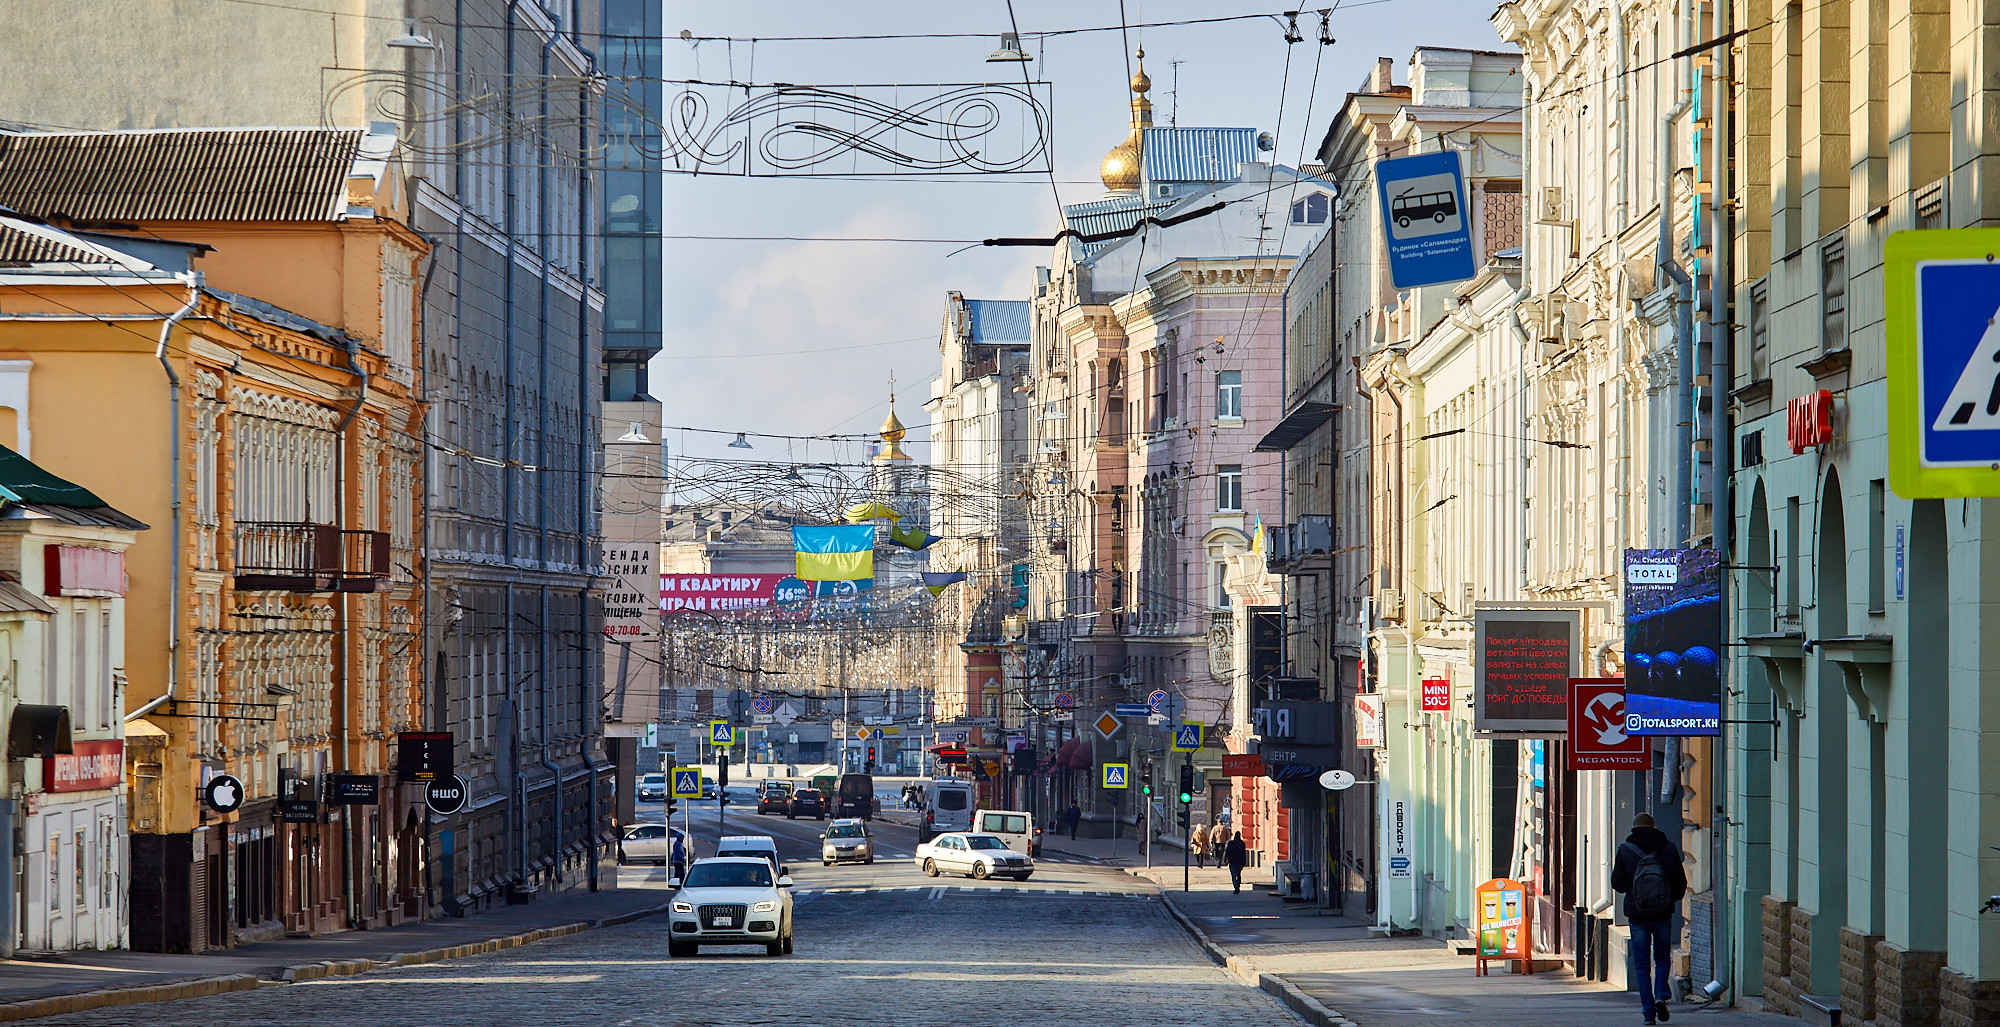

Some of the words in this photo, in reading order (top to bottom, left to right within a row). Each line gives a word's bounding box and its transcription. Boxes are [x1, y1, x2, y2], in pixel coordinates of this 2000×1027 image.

[1634, 569, 1671, 578] TOTAL
[681, 577, 762, 591] КВАРТИРУ
[1486, 636, 1568, 646] Покупка/продажа
[1486, 648, 1519, 657] ветхой
[1529, 648, 1567, 658] цветной
[1486, 661, 1524, 669] валюты
[1539, 661, 1567, 669] самых
[1488, 673, 1521, 681] лучших
[1524, 673, 1566, 681] условиях
[1424, 686, 1448, 695] MINI
[1486, 694, 1509, 703] ТОРГ
[1511, 694, 1527, 704] ДО
[1642, 718, 1719, 728] TOTALSPORT.KH
[431, 789, 459, 799] #ШО
[1396, 801, 1404, 854] АДВОКАТИ
